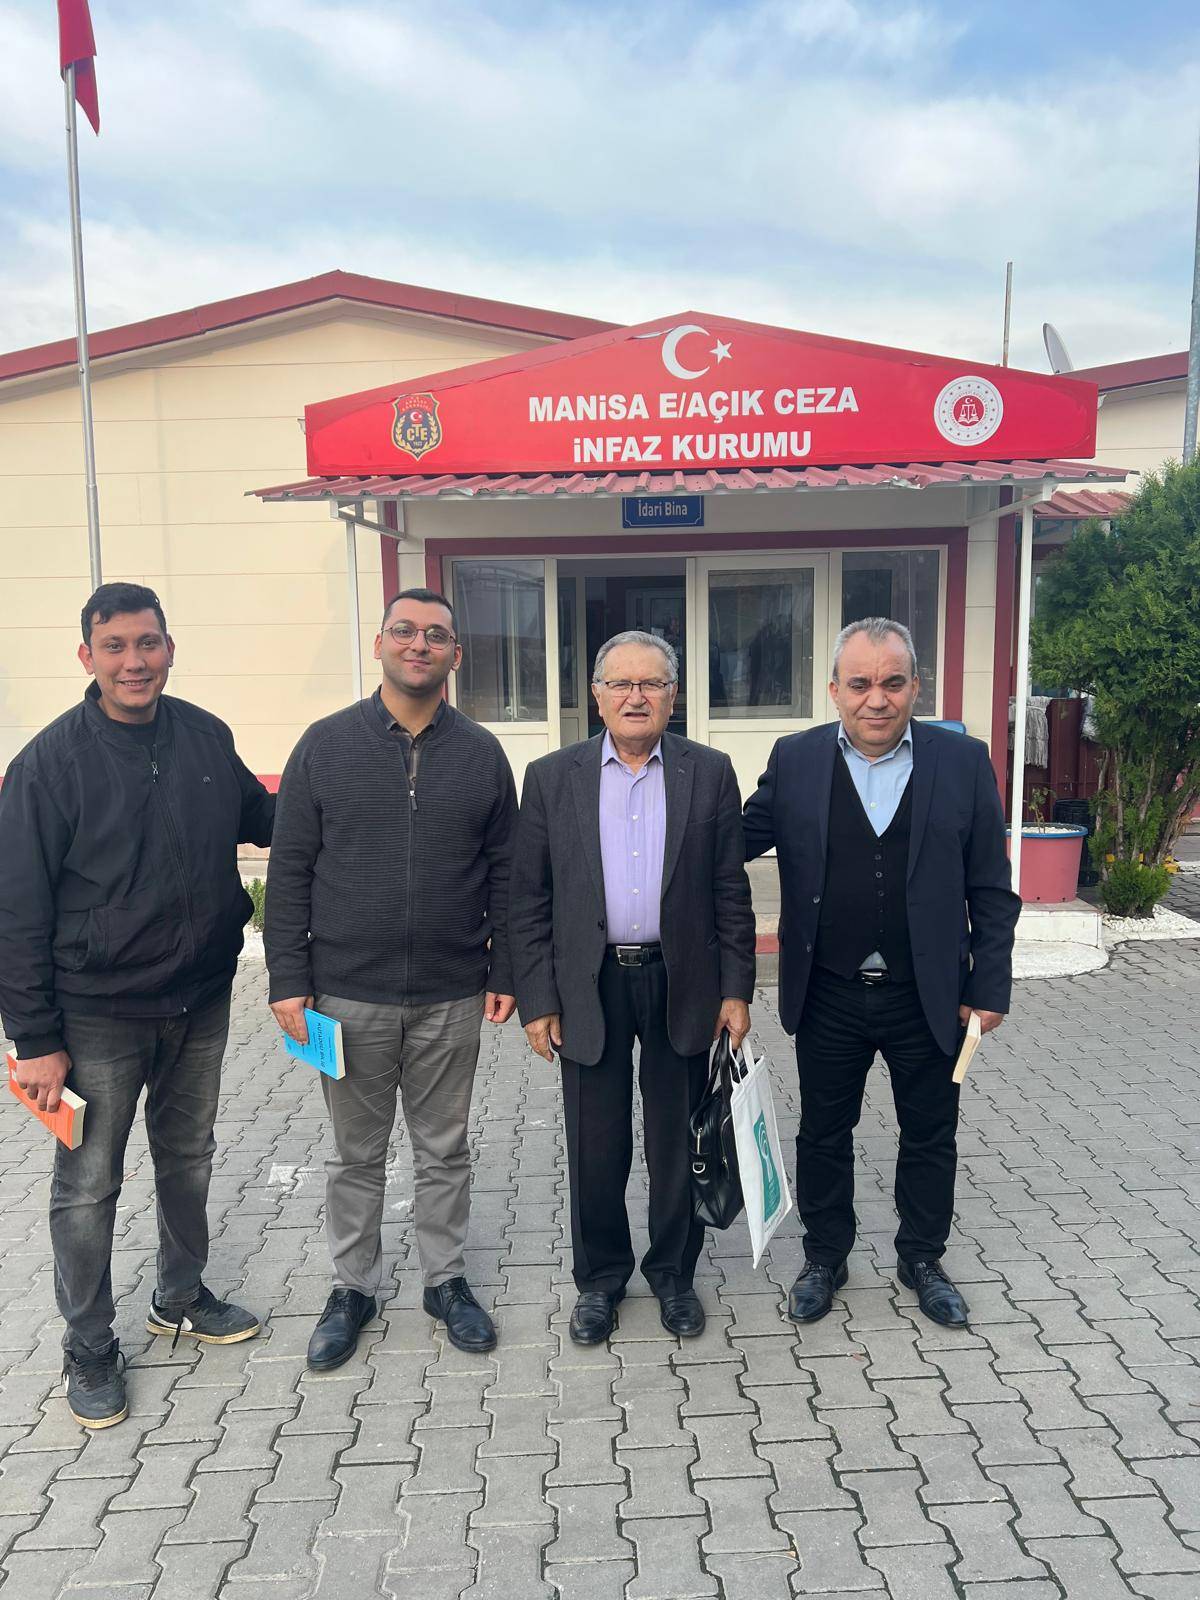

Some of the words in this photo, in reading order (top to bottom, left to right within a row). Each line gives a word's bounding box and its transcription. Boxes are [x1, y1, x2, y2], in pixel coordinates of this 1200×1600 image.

[659, 390, 764, 423] E/AÇIK
[774, 387, 859, 415] CEZA
[672, 431, 812, 461] KURUMU
[638, 499, 662, 517] İdari
[665, 501, 688, 516] Bina
